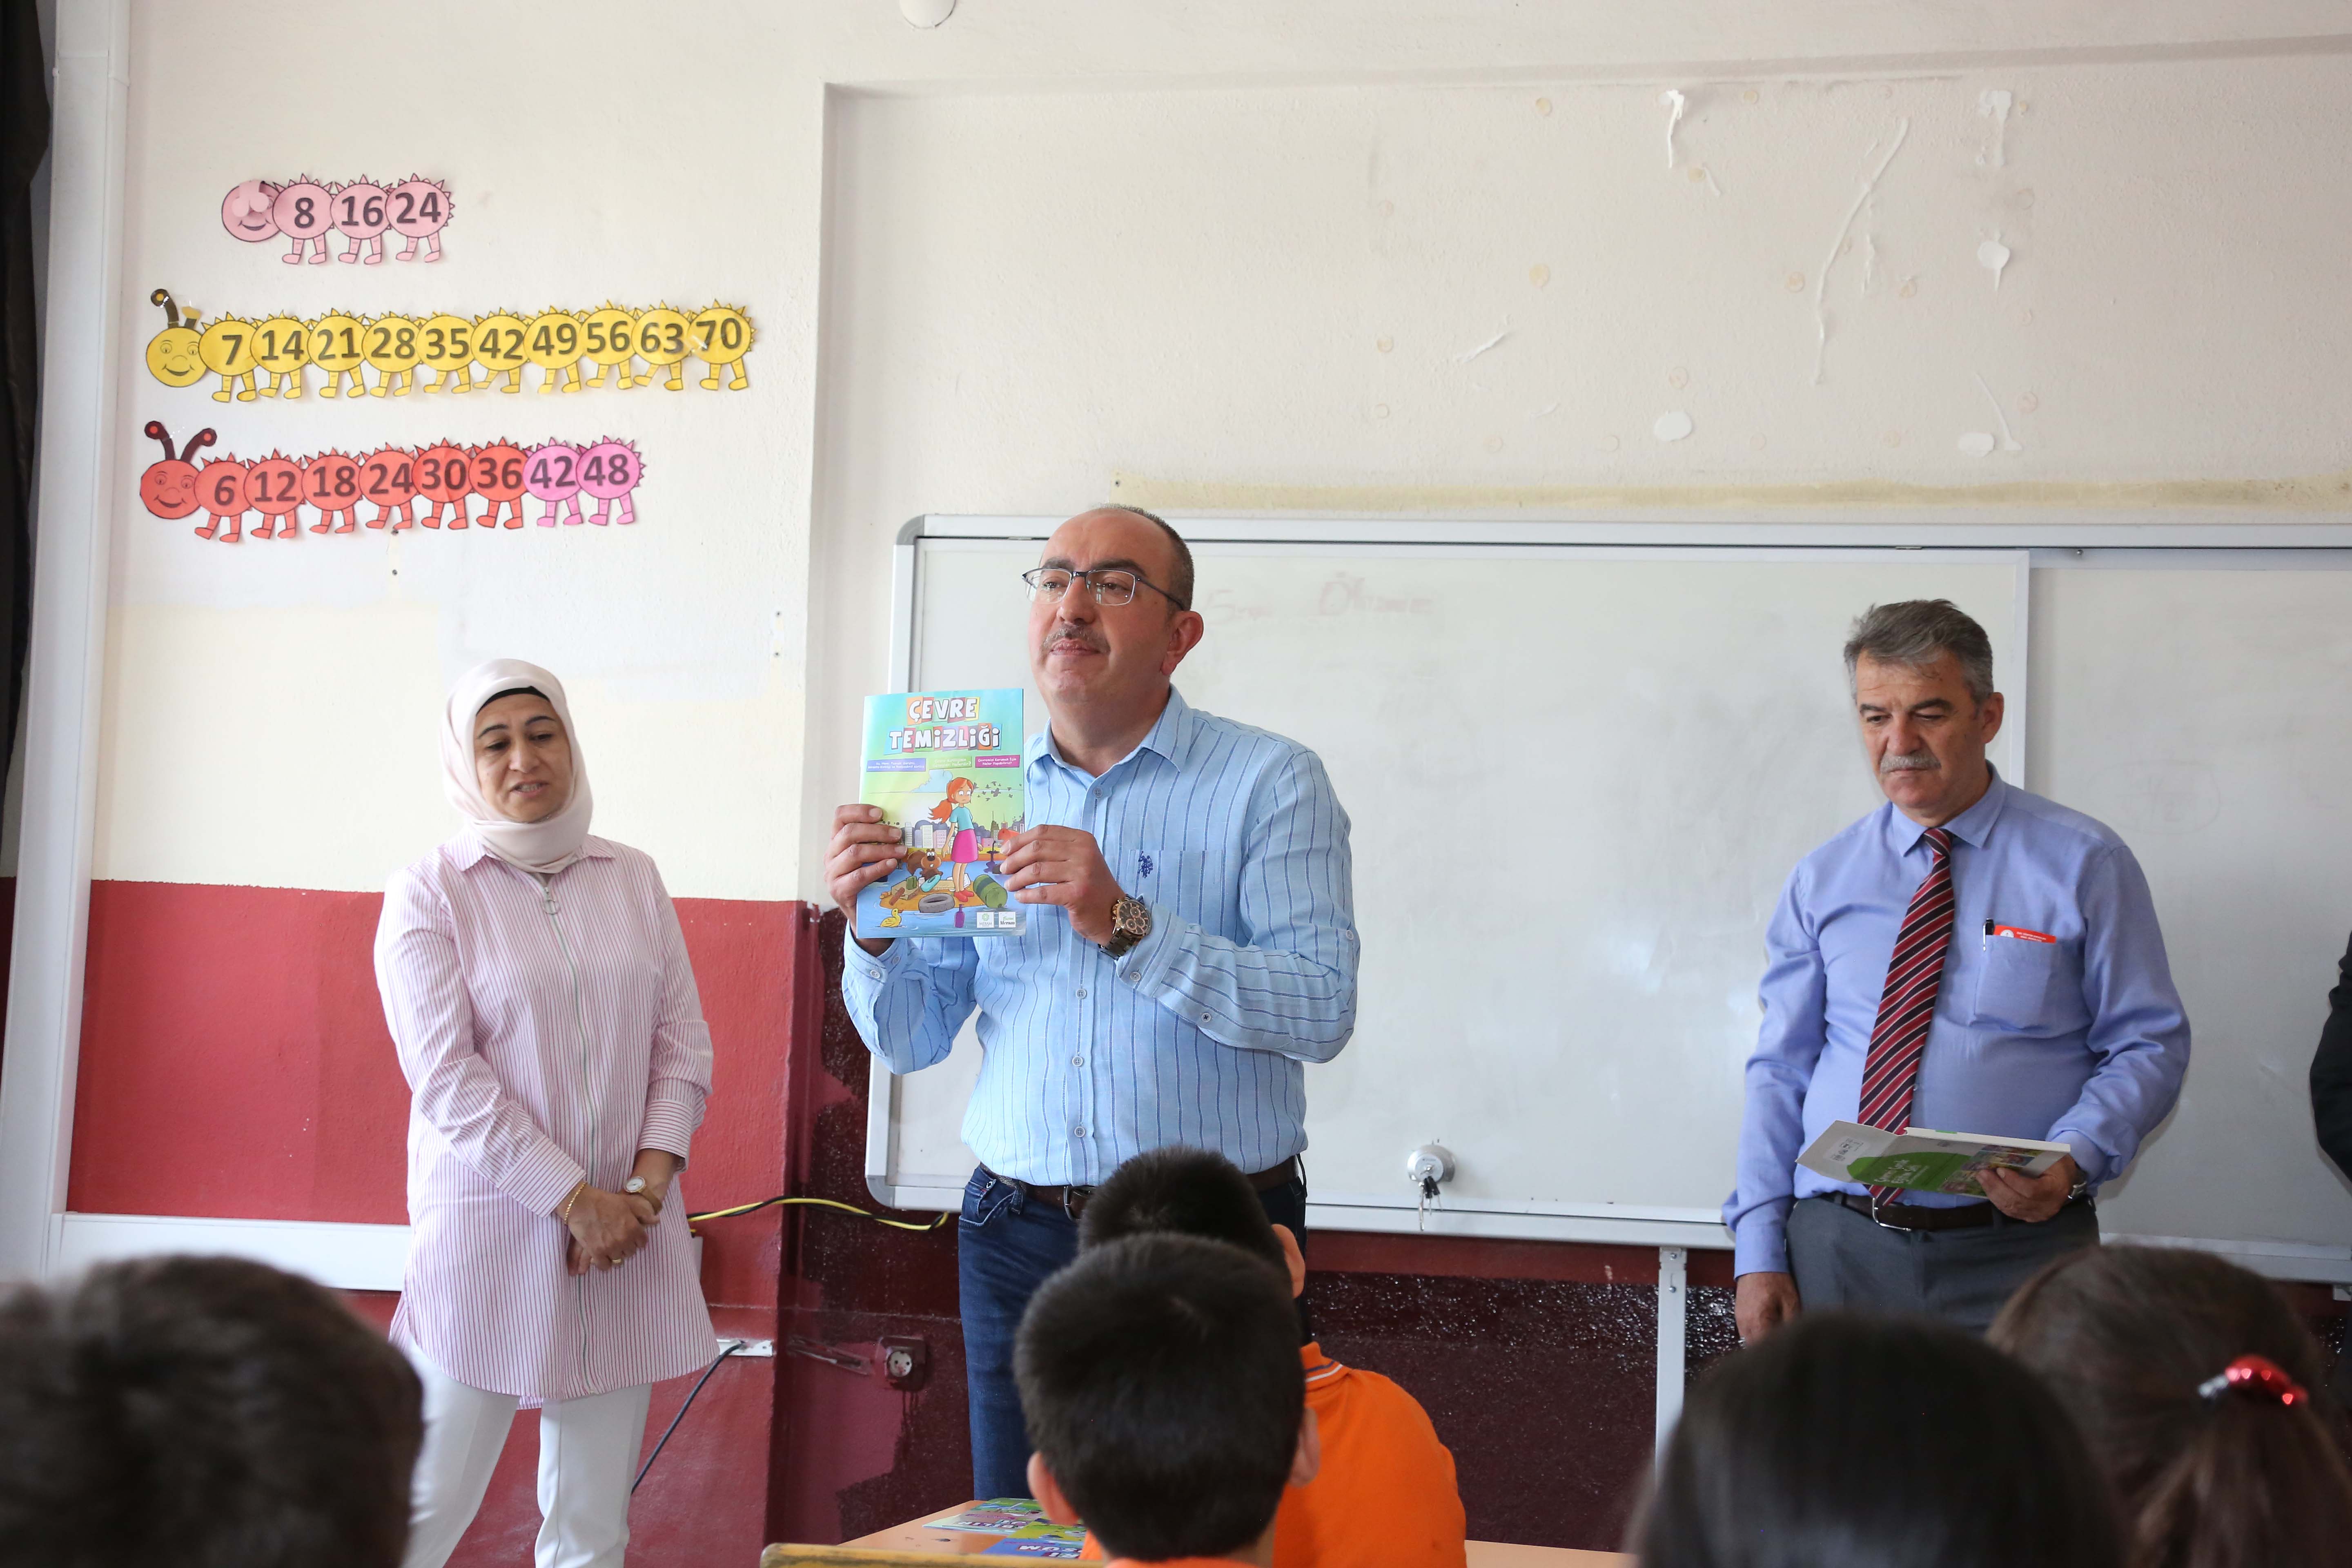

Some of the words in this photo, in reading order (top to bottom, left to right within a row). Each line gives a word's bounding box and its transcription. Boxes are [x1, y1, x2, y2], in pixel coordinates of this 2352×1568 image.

[294, 198, 314, 228] 8
[341, 196, 383, 227] 16
[395, 192, 441, 223] 24
[222, 334, 242, 365] 7
[262, 330, 304, 360] 14
[317, 327, 360, 360] 21
[371, 327, 415, 359] 28
[425, 328, 469, 359] 35
[479, 328, 523, 360] 42
[532, 323, 577, 355] 49
[586, 321, 630, 353] 56
[640, 323, 683, 354] 63
[696, 318, 742, 352] 70
[214, 476, 236, 506] 6
[254, 471, 296, 502] 12
[312, 466, 356, 497] 18
[369, 463, 413, 494] 24
[421, 458, 467, 490] 30
[477, 457, 522, 489] 36
[530, 455, 576, 488] 42
[583, 454, 629, 486] 48
[909, 699, 977, 722] ÇEVRE
